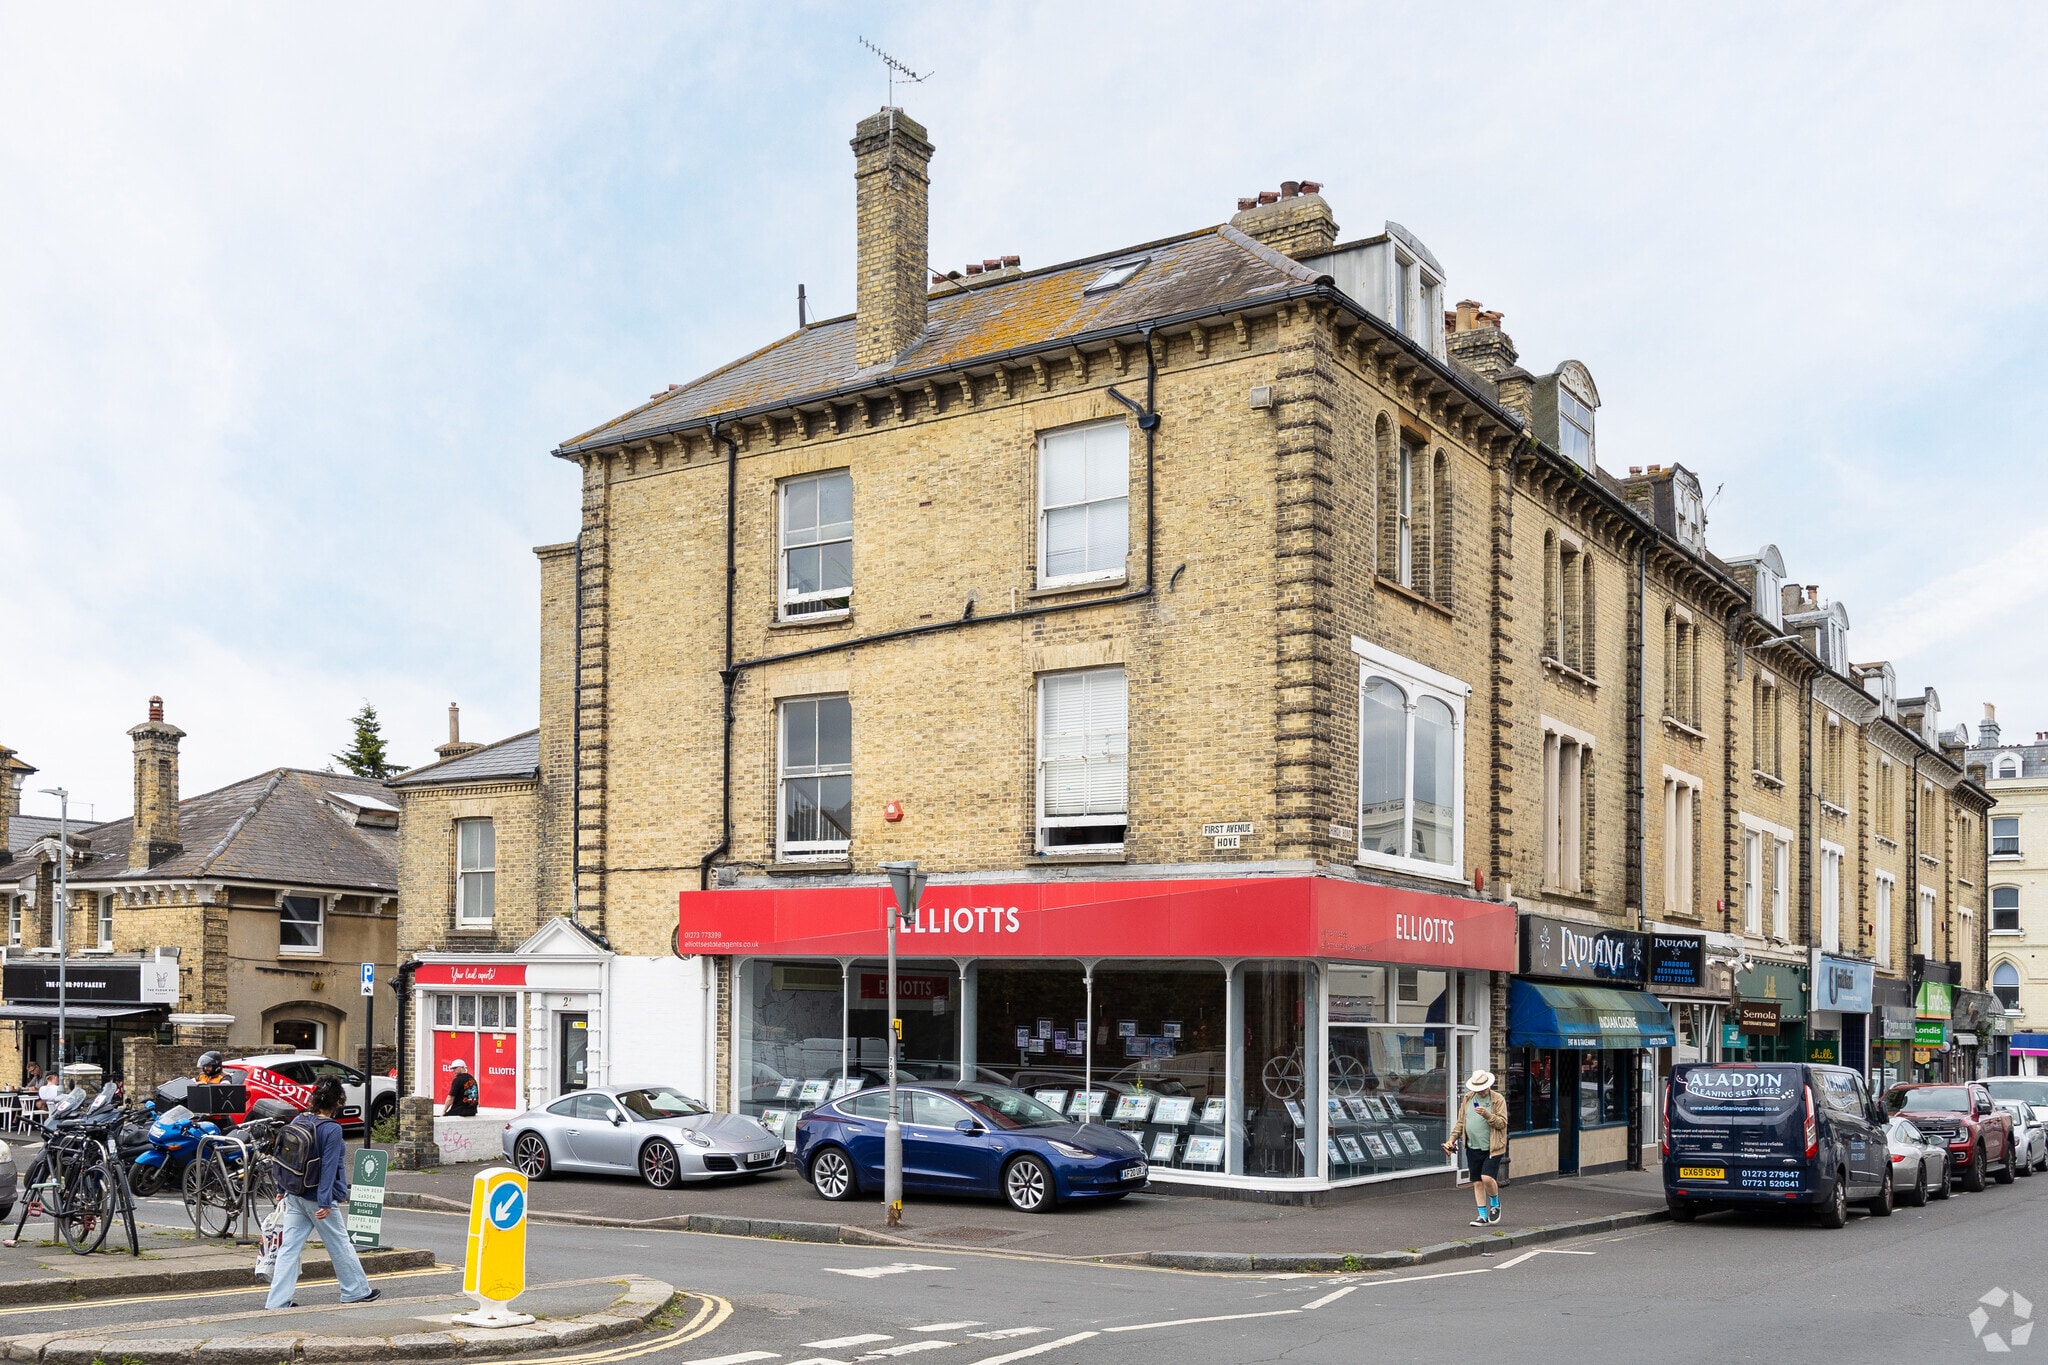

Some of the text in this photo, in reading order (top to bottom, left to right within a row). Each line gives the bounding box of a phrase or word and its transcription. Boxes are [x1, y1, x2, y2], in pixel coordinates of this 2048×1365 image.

[1204, 823, 1251, 834] FIRST AVENUE
[1217, 837, 1237, 847] HOVE
[1396, 913, 1454, 945] ELLIOTTS
[684, 931, 700, 939] 01273
[684, 941, 759, 950] elliottsestateagents.co.uk
[1654, 937, 1699, 949] INDIANA
[1560, 926, 1625, 974] INDIANA
[1661, 960, 1690, 968] TANDOORI
[364, 965, 373, 983] P
[451, 966, 464, 983] Your
[1656, 967, 1693, 976] RESTAURANT
[84, 981, 107, 989] BAKERY
[1743, 1009, 1777, 1020] Semola
[1598, 1016, 1638, 1029] INDIAN CUISINE
[1915, 1026, 1941, 1034] Londis
[1811, 1048, 1834, 1060] chilli
[442, 1064, 468, 1074] ELLS
[488, 1066, 516, 1076] ELLIOTTS
[1690, 1073, 1782, 1087] ALADDIN
[253, 1068, 312, 1104] ELLIOTT
[1691, 1086, 1781, 1098] CLEANING SERVICES
[1683, 1168, 1721, 1177] GX69 GSY
[1741, 1170, 1767, 1178] 01273
[354, 1201, 378, 1209] DELICIOUS
